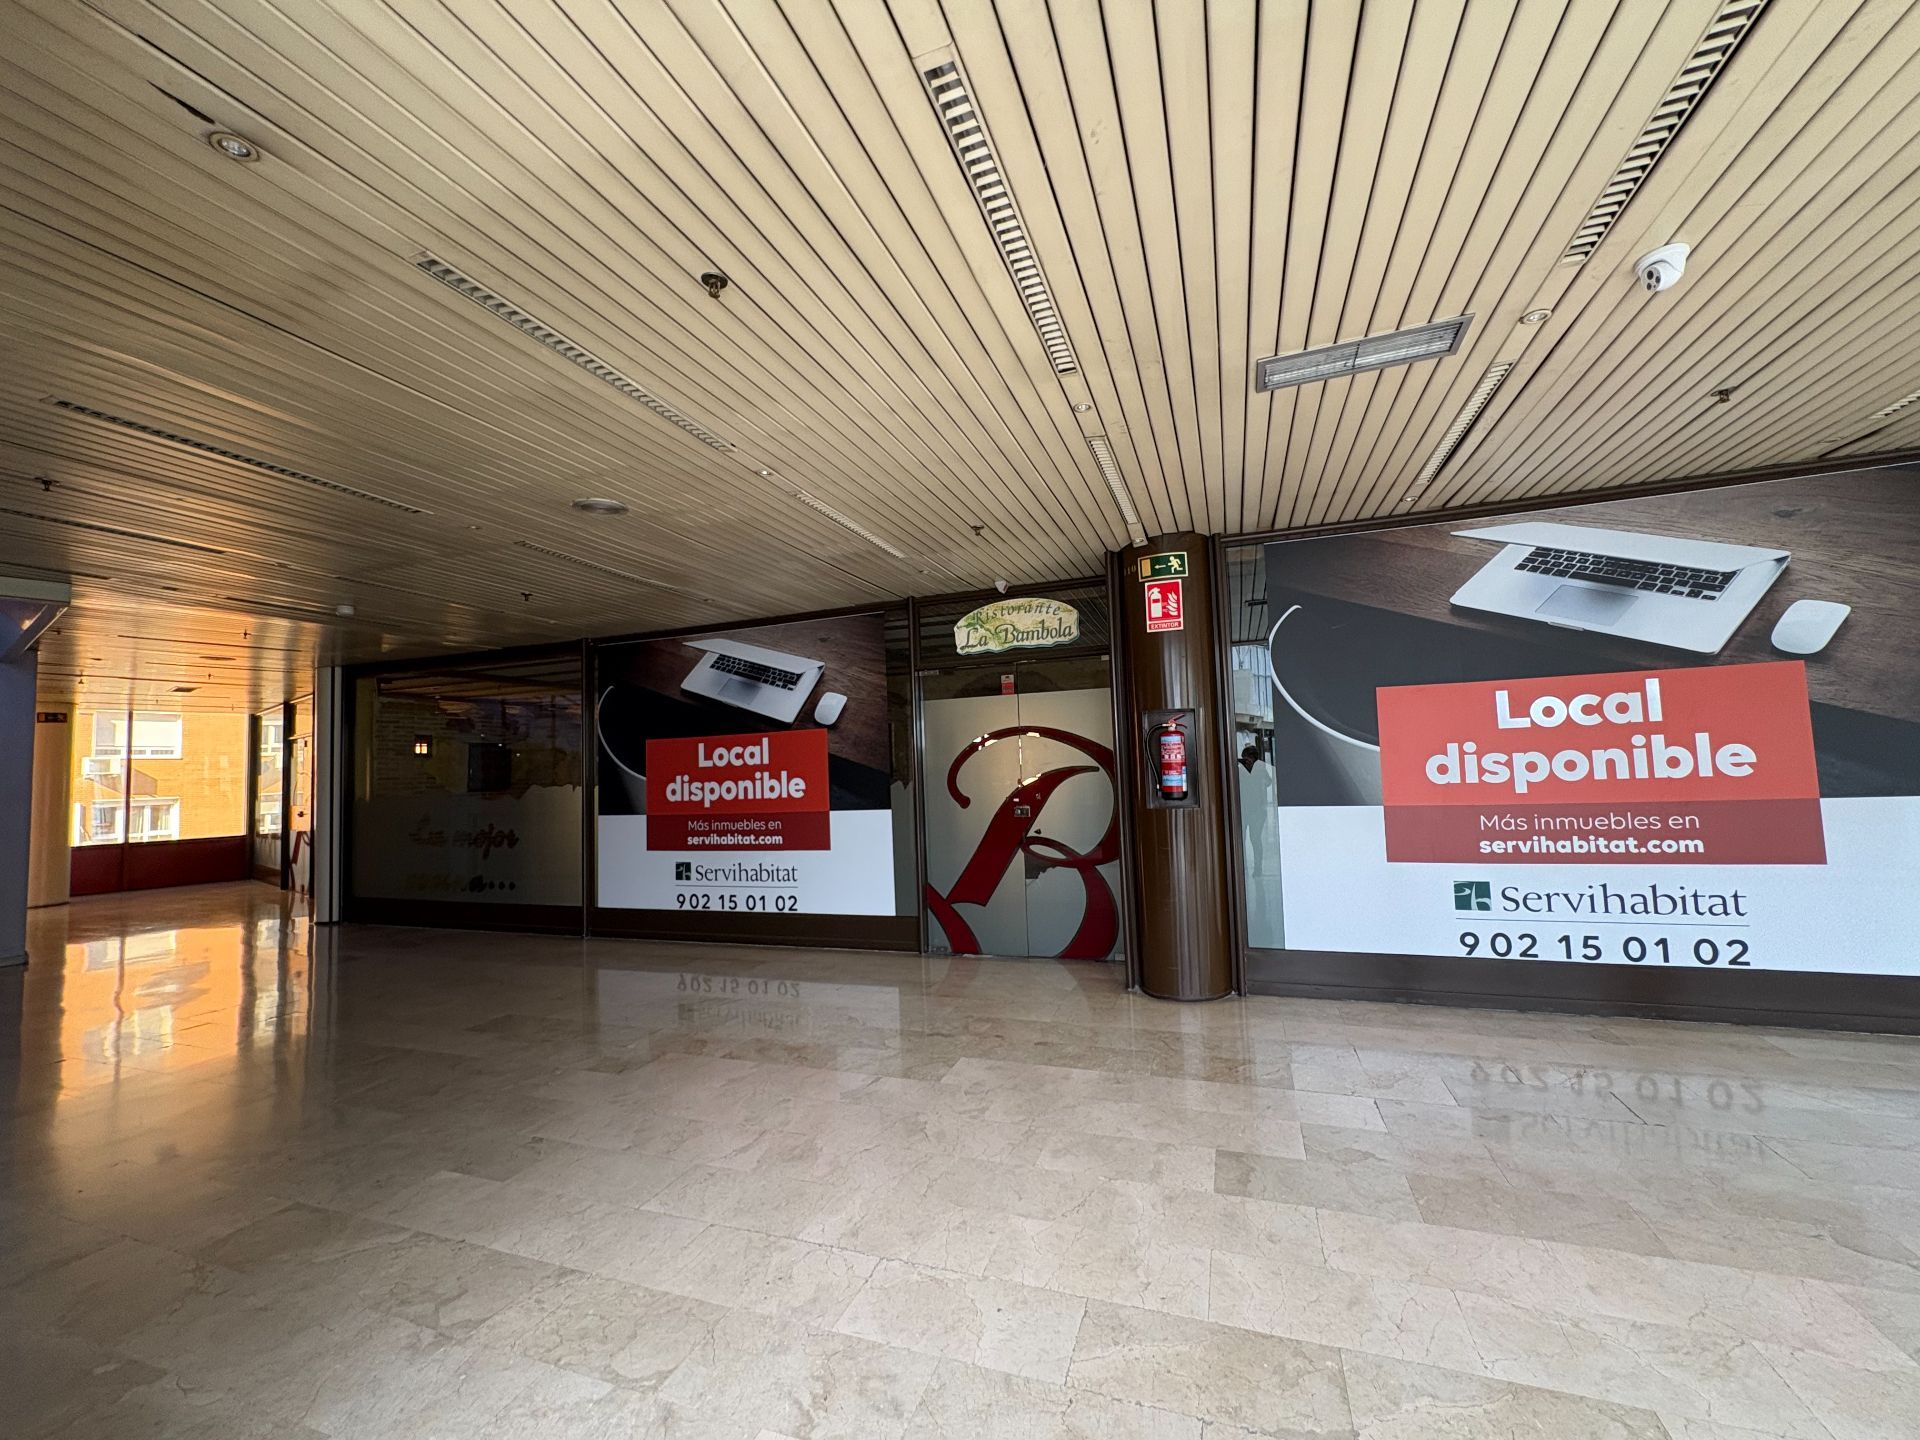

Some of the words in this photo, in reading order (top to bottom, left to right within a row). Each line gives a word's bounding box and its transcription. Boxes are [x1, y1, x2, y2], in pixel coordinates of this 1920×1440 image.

[974, 603, 1060, 625] Ristorante
[1150, 621, 1179, 629] EXTINTOR
[961, 628, 987, 650] La
[995, 617, 1073, 645] Bambola
[1495, 678, 1663, 729] Local
[698, 738, 769, 768] Local
[1425, 732, 1757, 794] disponible
[666, 771, 806, 808] disponible
[688, 819, 709, 831] Más
[711, 819, 766, 830] inmuebles
[768, 821, 782, 830] en
[1480, 812, 1528, 831] Más
[1534, 812, 1662, 831] inmuebles
[1669, 815, 1700, 829] en
[687, 834, 783, 845] servihabitat.com
[1479, 836, 1704, 855] servihabitat.com
[695, 862, 798, 883] Servihabitat
[676, 893, 710, 909] 902
[718, 895, 738, 911] 15
[746, 895, 766, 911] 01
[775, 896, 798, 912] 02
[1501, 883, 1748, 917] Servihabitat
[1459, 932, 1539, 959] 902
[1557, 934, 1603, 961] 15
[1622, 936, 1670, 963] 01
[1693, 938, 1751, 966] 02
